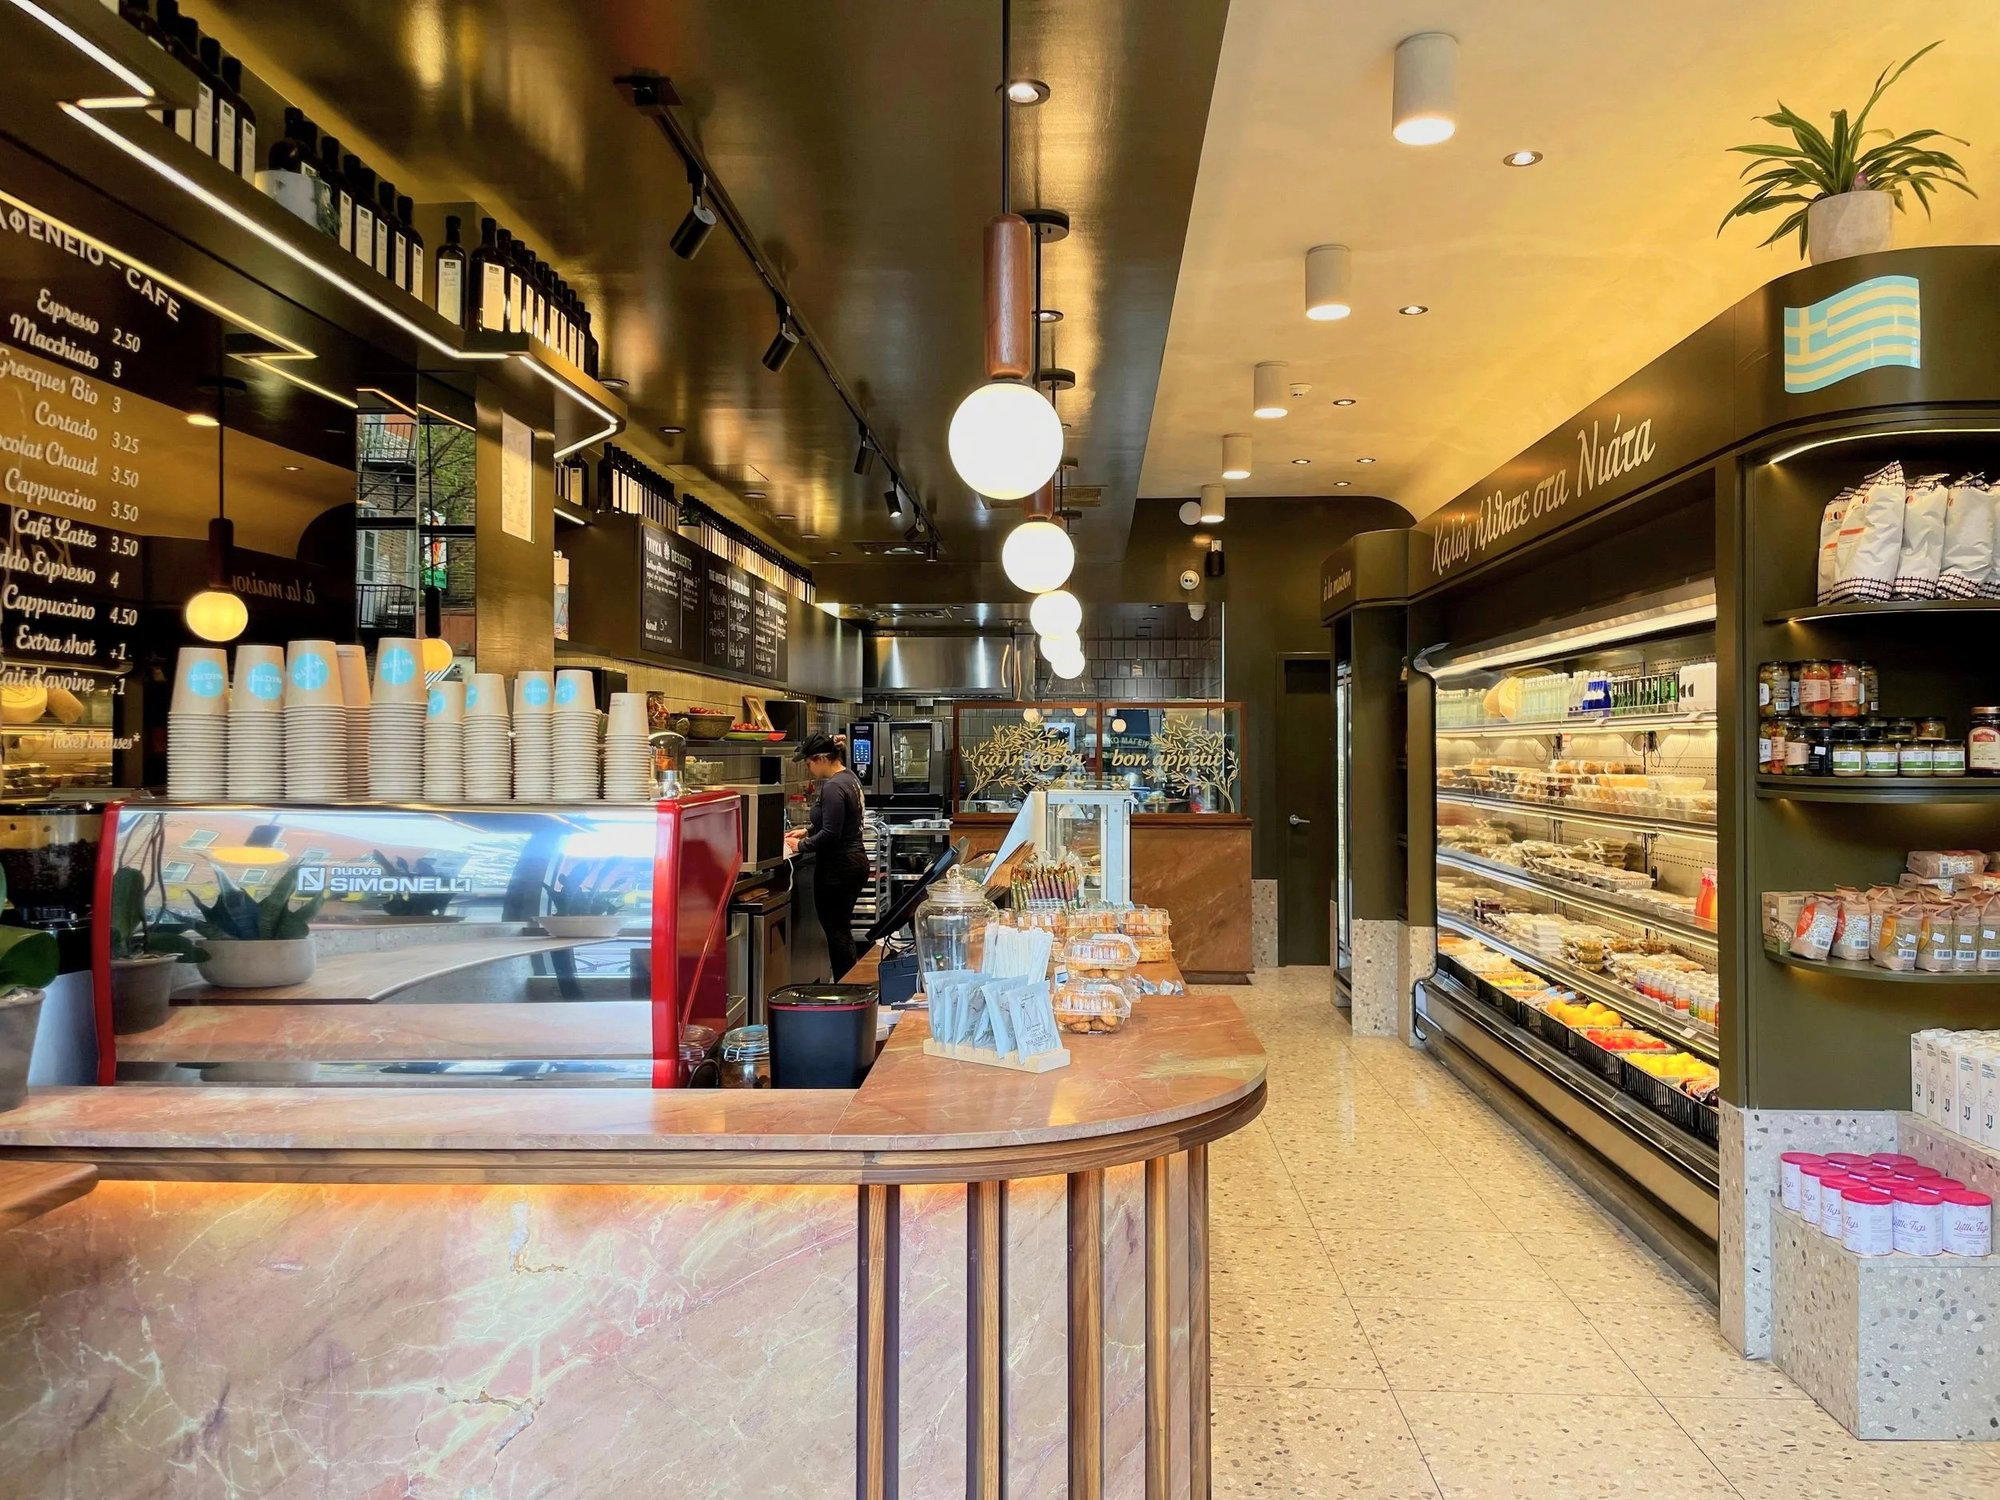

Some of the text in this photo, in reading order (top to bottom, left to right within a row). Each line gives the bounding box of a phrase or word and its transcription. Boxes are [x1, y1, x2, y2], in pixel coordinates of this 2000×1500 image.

[126, 267, 181, 322] CAFE
[37, 289, 140, 353] Espresso 2.50
[10, 314, 121, 378] Macchiato 3
[70, 376, 99, 405] Bio
[112, 396, 121, 413] 3
[35, 401, 139, 453] Cortado 3.25
[46, 441, 98, 475] Chaud
[111, 466, 139, 488] 3.50
[1533, 469, 1569, 518] στα
[1577, 413, 1656, 498] Νιάτα
[5, 468, 139, 522] Cappuccino 3.50
[14, 509, 139, 557] Café Latte 3.50
[33, 551, 96, 584] Espresso
[110, 571, 120, 588] 4
[3, 584, 138, 626] Cappuccino 4.50
[16, 625, 126, 660] Extra shot +1
[110, 679, 126, 695] +1
[1112, 749, 1150, 767] bon
[330, 877, 472, 892] SIMONELLI
[331, 866, 381, 876] nuova
